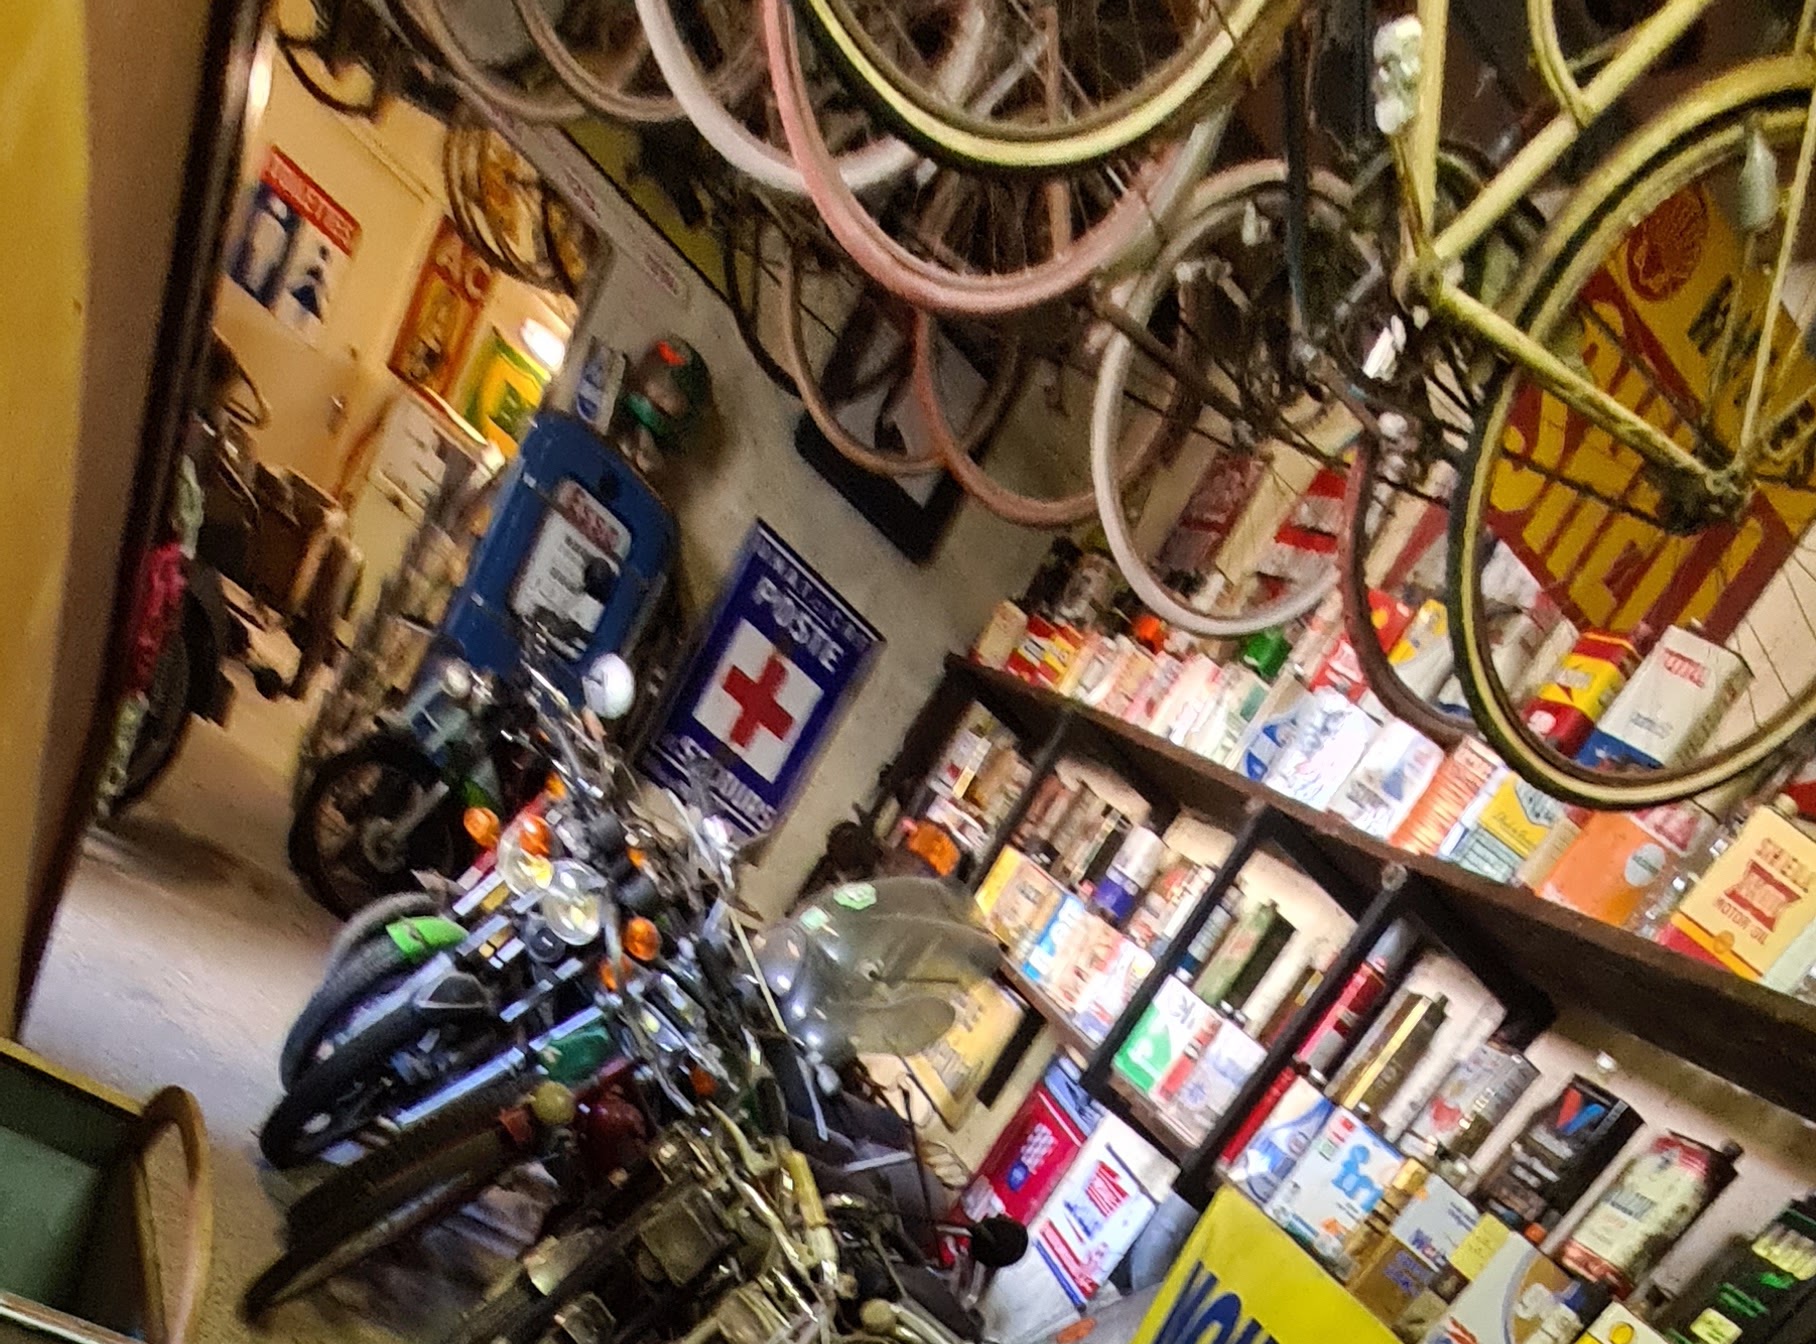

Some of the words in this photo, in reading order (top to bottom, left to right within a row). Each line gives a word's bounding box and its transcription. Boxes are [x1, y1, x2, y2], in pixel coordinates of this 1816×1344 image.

[755, 576, 844, 673] POSTE
[680, 735, 777, 831] SOURS
[1753, 837, 1815, 895] SHELL
[1715, 896, 1752, 933] MOTOR
